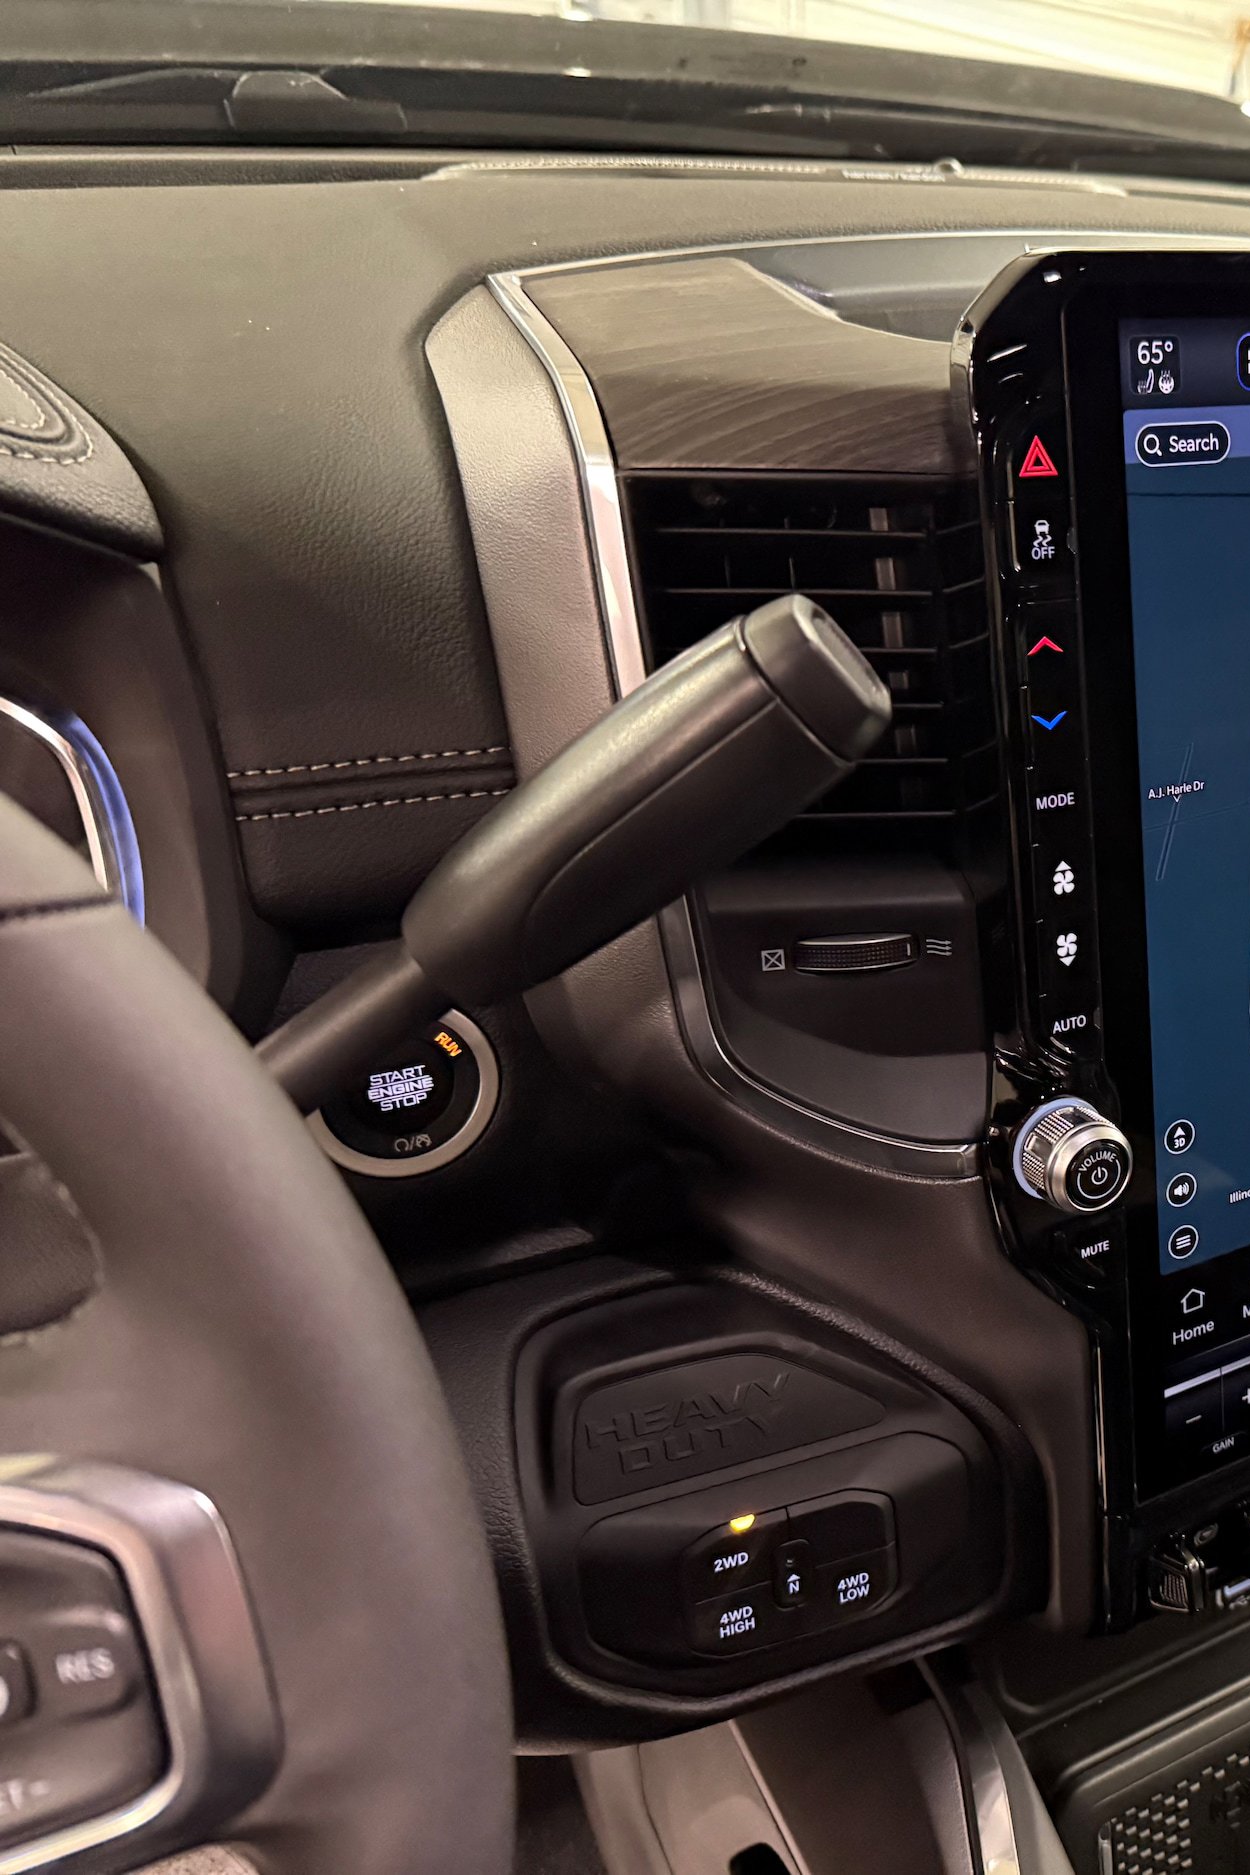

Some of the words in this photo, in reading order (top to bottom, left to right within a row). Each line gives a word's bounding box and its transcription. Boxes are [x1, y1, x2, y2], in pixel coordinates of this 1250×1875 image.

[1168, 434, 1219, 455] Search
[1031, 545, 1056, 561] OFF
[1148, 786, 1166, 800] A.J.
[1166, 783, 1193, 796] Harle
[1192, 780, 1205, 793] Dr
[1035, 791, 1076, 812] MODE
[1052, 1014, 1087, 1035] AUTO
[434, 1031, 463, 1057] RUN
[370, 1064, 426, 1087] START
[367, 1076, 435, 1101] ENGINE
[380, 1091, 428, 1112] STOP
[1174, 1137, 1186, 1149] 3D
[1078, 1151, 1117, 1173] VOLUME
[1081, 1240, 1110, 1259] MUTE
[1172, 1319, 1215, 1345] Home
[585, 1372, 789, 1450] HEAVY
[618, 1414, 765, 1476] DUTY
[1212, 1436, 1235, 1453] GAIN
[714, 1551, 749, 1573] 2WD
[789, 1581, 800, 1594] N
[838, 1572, 870, 1592] 4WD
[839, 1583, 870, 1604] LOW
[720, 1605, 753, 1626] 4WD
[719, 1616, 756, 1639] HIGH
[56, 1648, 115, 1683] RES
